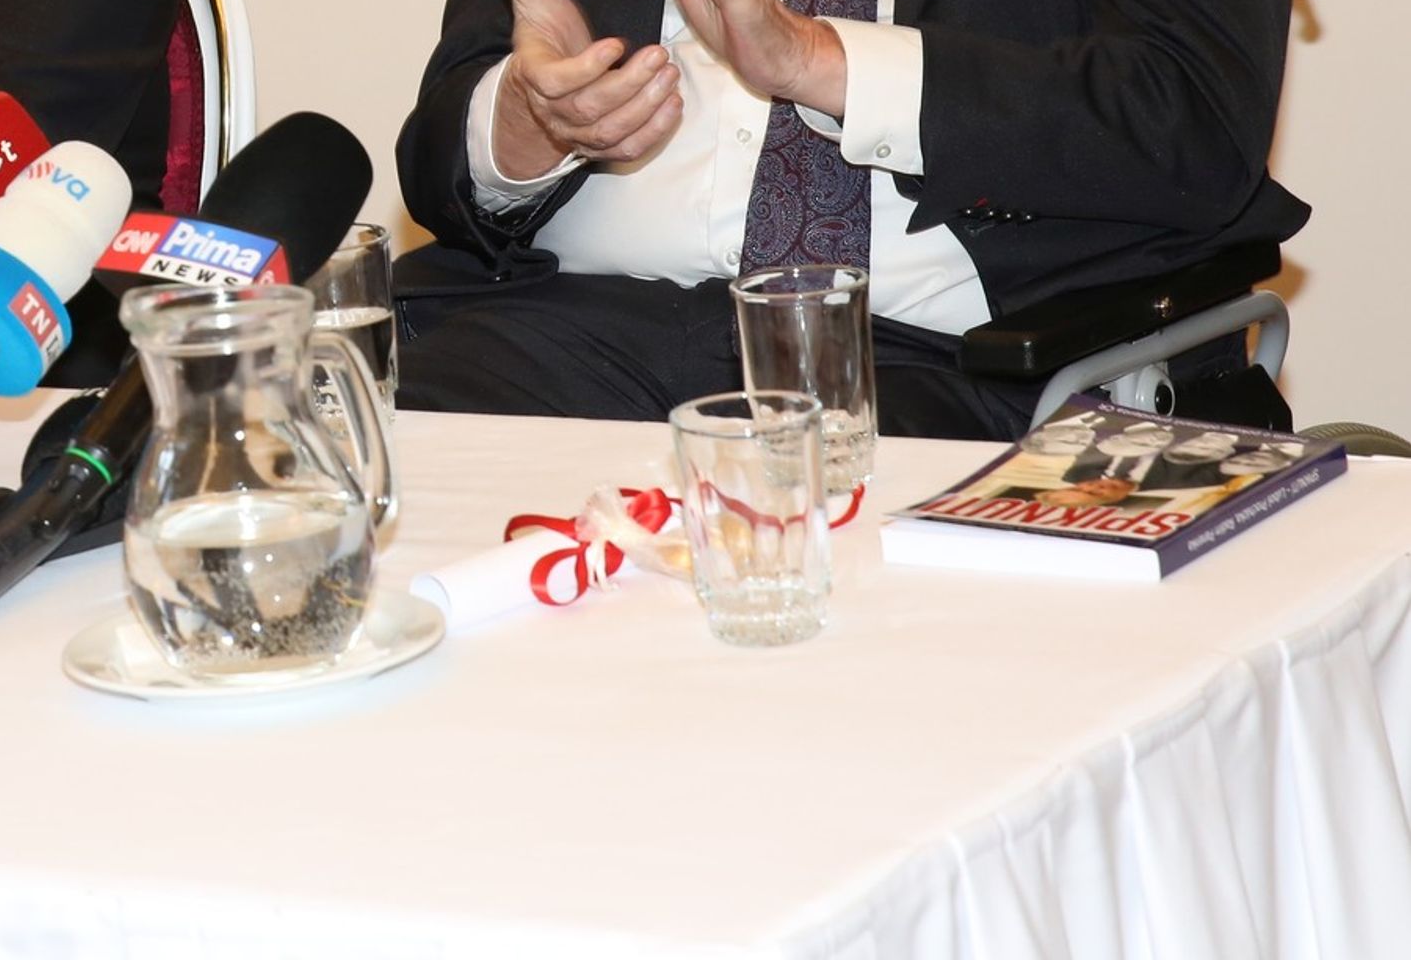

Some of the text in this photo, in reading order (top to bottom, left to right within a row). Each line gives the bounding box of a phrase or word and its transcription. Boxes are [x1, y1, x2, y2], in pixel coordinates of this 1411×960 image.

[112, 221, 261, 274] CNN Prima
[21, 292, 51, 336] TN
